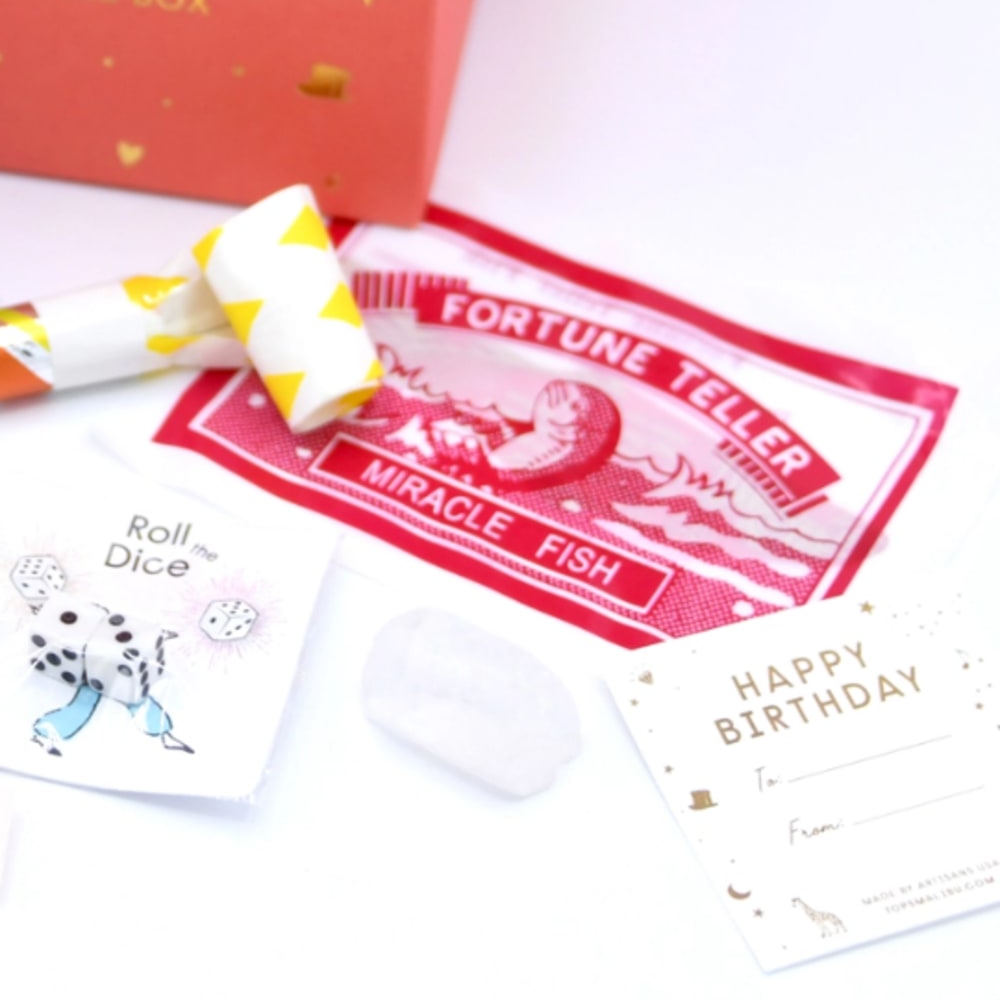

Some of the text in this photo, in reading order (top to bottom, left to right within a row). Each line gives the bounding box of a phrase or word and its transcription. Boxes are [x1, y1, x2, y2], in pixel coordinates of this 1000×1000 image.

[440, 292, 661, 375] FORTUNE
[670, 358, 813, 479] TELLER
[126, 513, 220, 562] Roll the
[359, 458, 622, 588] MIRACLE FISH
[103, 541, 191, 578] Dice
[713, 665, 922, 746] BIRTHDAY
[730, 641, 867, 702] HAPPY
